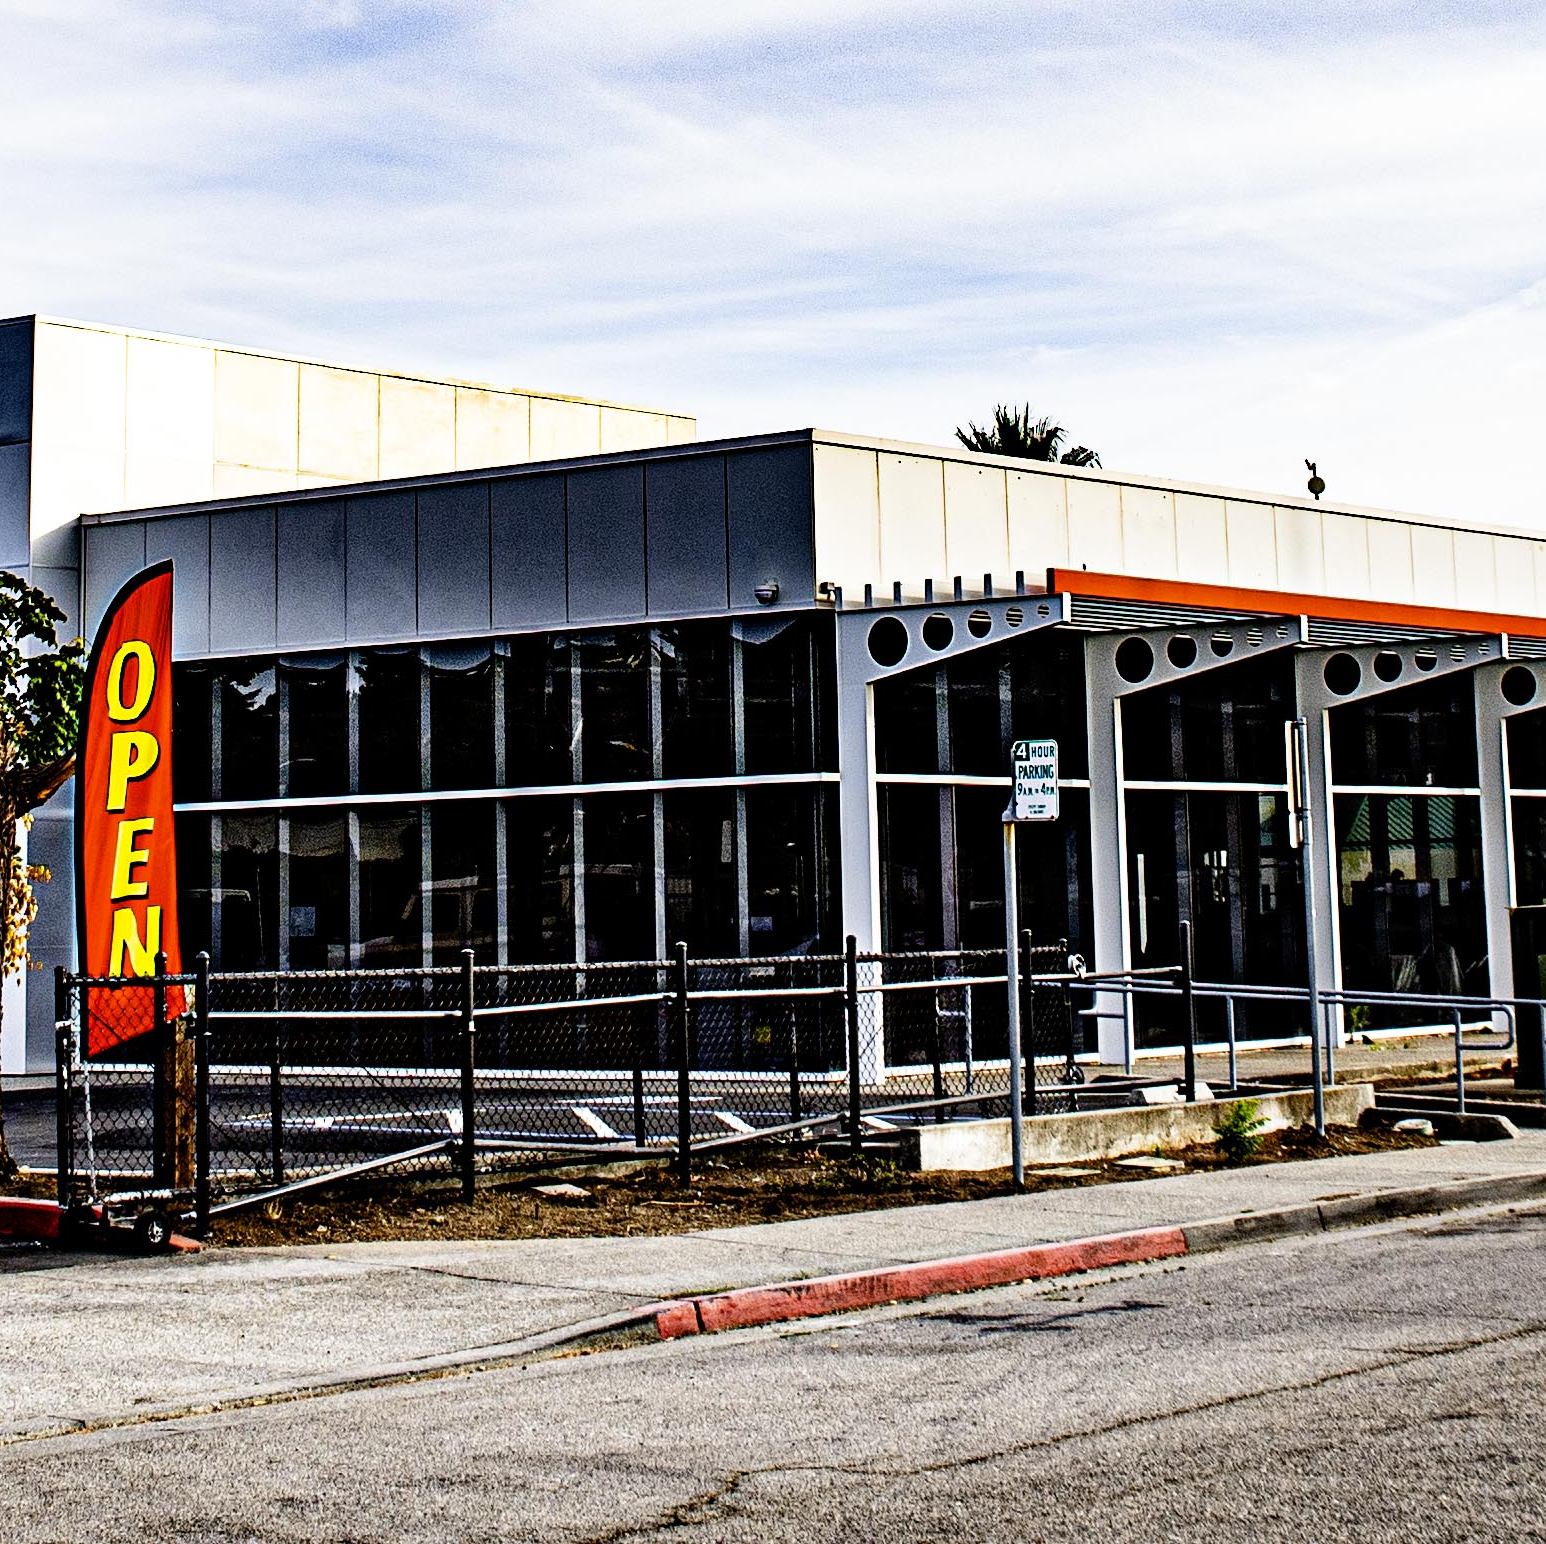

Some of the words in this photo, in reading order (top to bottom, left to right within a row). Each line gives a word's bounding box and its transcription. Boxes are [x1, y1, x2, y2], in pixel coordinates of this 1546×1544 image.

[1016, 743, 1027, 759] 4
[1031, 745, 1055, 758] HOUR
[1018, 763, 1054, 780] PARKING
[105, 639, 161, 979] OPEN
